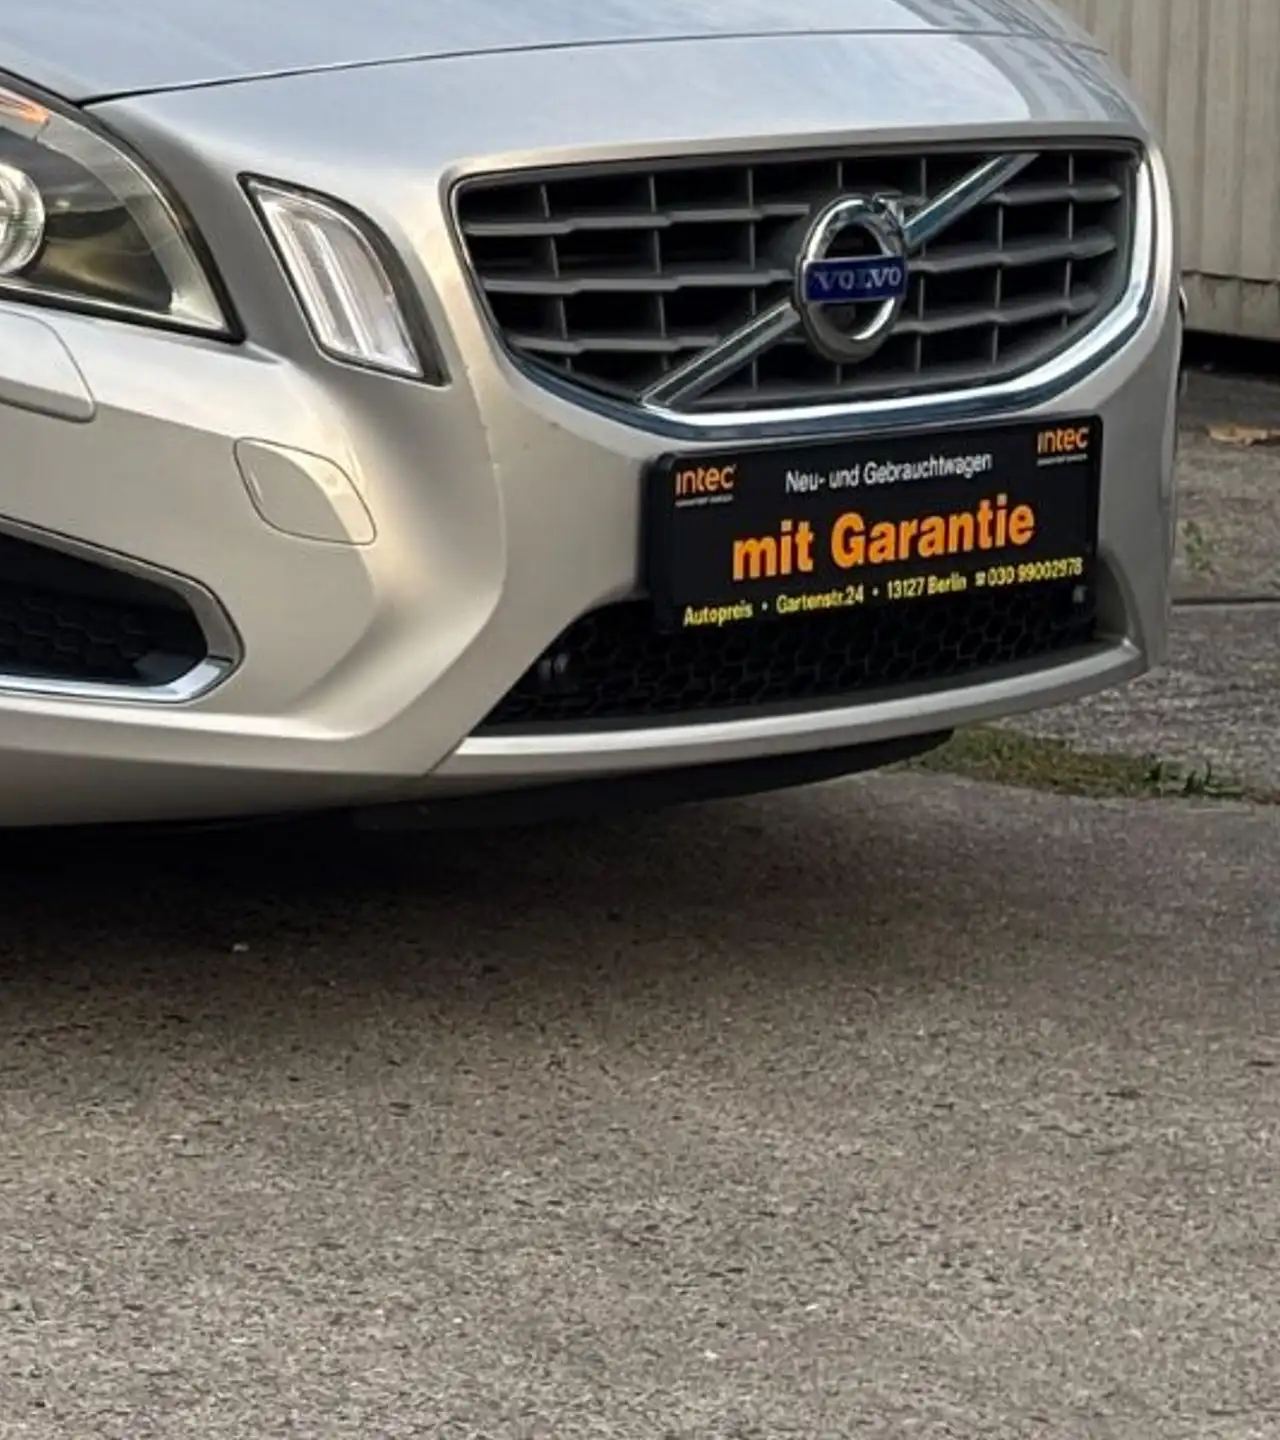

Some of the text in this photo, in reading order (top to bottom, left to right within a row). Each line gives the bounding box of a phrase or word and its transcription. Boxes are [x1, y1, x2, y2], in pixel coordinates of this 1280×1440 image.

[814, 266, 902, 293] VOLVO
[1037, 426, 1090, 454] intec
[675, 464, 737, 496] intec
[785, 452, 993, 494] Neu- und Gebrauchtwagen
[732, 492, 1036, 582] mit Garantie
[683, 600, 754, 627] Autopreis
[887, 575, 925, 600] 13127
[927, 571, 968, 596] Berlin
[989, 566, 1016, 588] 030
